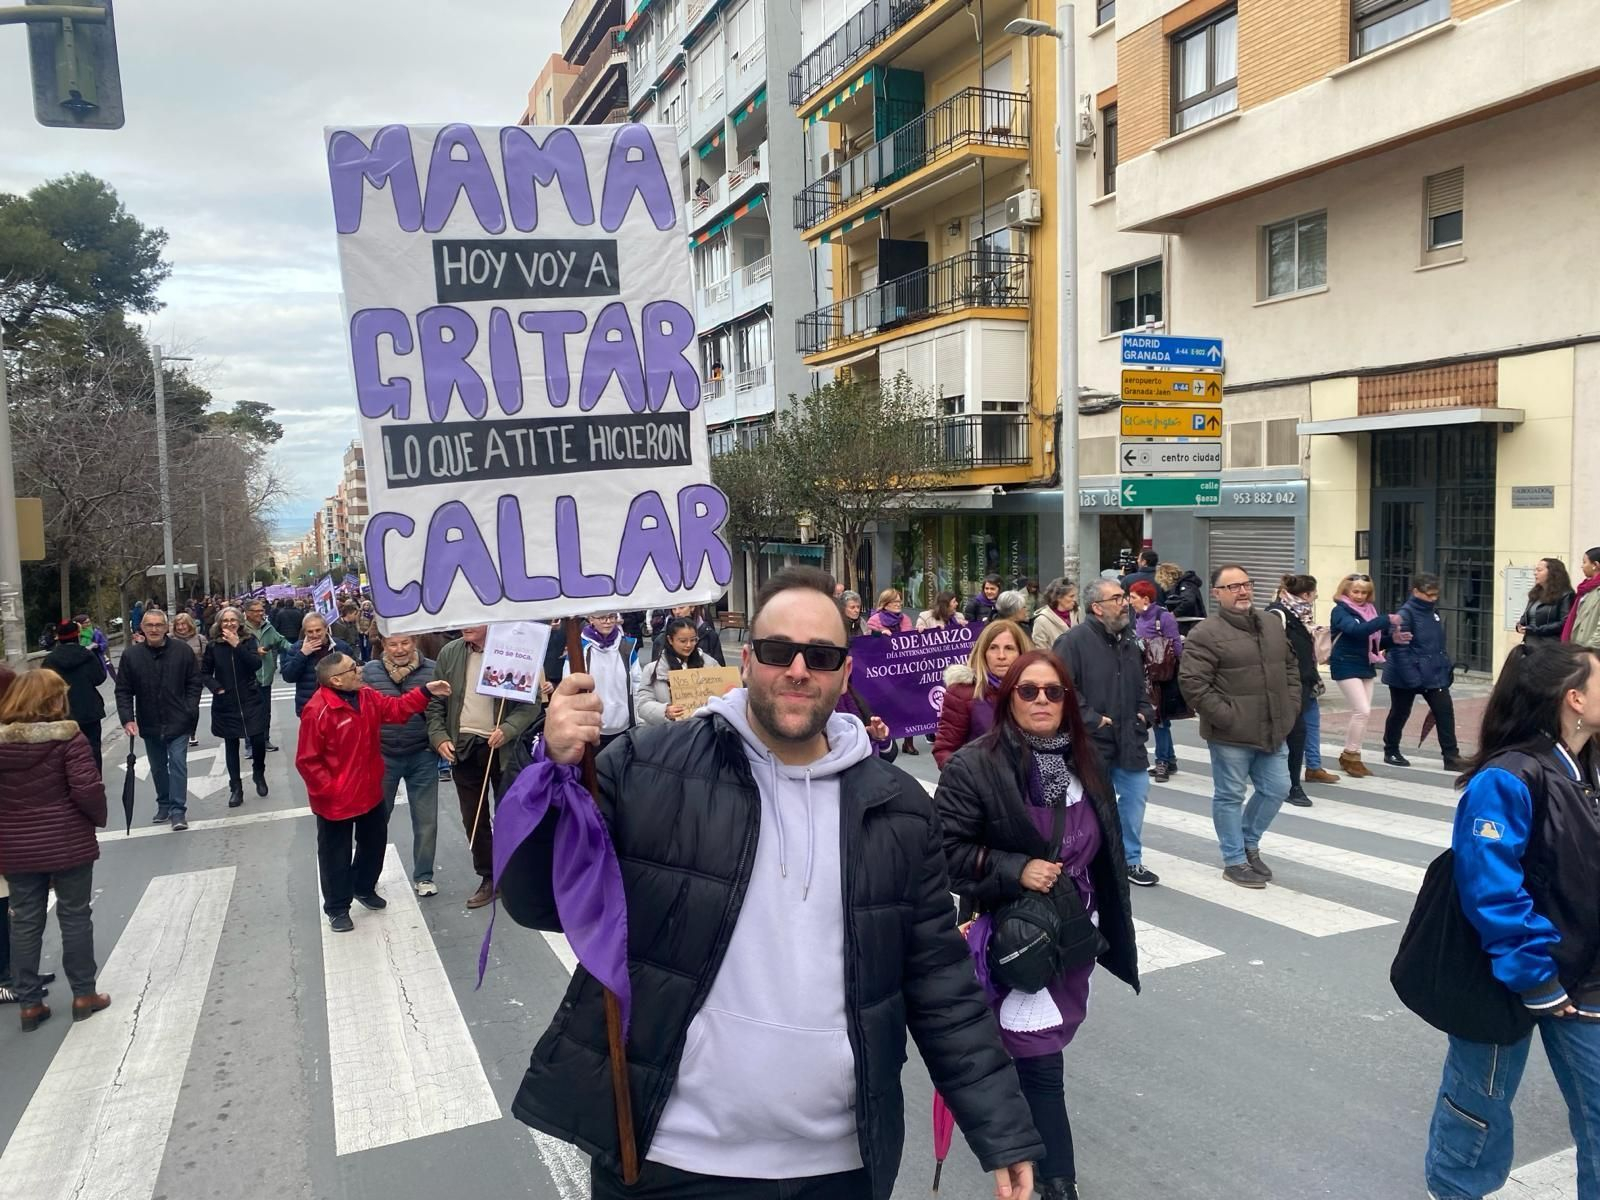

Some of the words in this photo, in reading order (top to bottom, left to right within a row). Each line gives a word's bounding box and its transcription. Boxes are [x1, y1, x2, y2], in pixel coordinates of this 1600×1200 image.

[327, 123, 676, 234] MAMA
[443, 246, 507, 288] HOY
[514, 249, 576, 288] VOY
[585, 251, 611, 288] A
[1124, 338, 1160, 348] MADRID
[350, 300, 700, 422] GRITAR
[1124, 350, 1171, 361] GRANADA
[1124, 377, 1162, 386] aeropuerto
[1195, 415, 1204, 429] P
[384, 435, 421, 481] LO
[428, 432, 479, 477] QUE
[588, 423, 687, 462] HICIERON
[1161, 453, 1189, 462] centro
[1192, 452, 1220, 461] ciudad
[1200, 481, 1218, 490] calle
[1233, 492, 1251, 504] 953
[1254, 492, 1273, 504] 882
[1276, 491, 1296, 503] 042
[364, 484, 732, 618] CALLAR
[891, 638, 899, 651] 8
[900, 634, 919, 650] DE
[920, 627, 972, 647] MARZO
[494, 648, 504, 656] no
[886, 651, 898, 659] DÍA
[899, 646, 941, 657] INTERNACIONAL
[866, 657, 936, 678] ASOCIACIÓN
[904, 722, 936, 733] SANTIAGO
